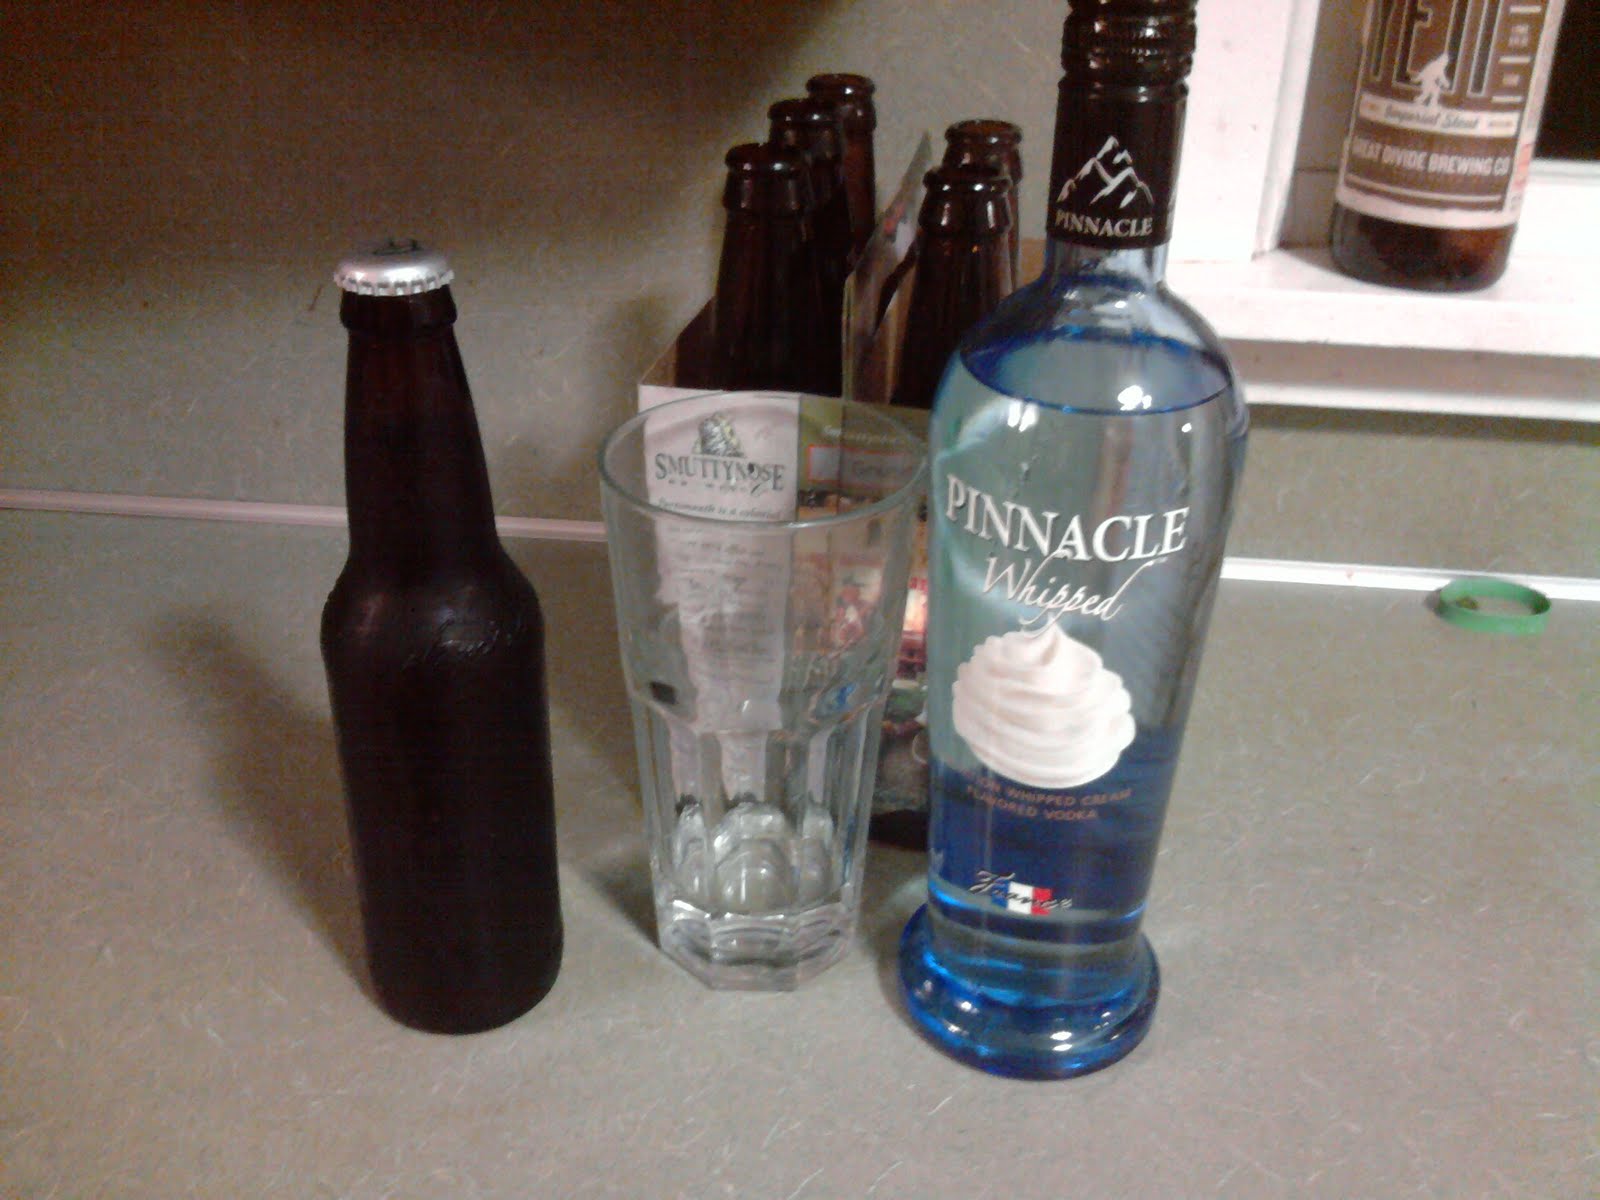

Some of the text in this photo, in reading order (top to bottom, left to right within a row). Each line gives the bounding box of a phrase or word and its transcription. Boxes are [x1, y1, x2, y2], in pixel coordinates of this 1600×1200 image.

[1428, 152, 1494, 176] BREWING
[1055, 209, 1153, 237] PINNACLE
[655, 453, 785, 491] SMUTTYNOSE
[946, 473, 1190, 562] PINNACLE
[983, 546, 1167, 626] Whipped
[1043, 808, 1097, 821] VODKA
